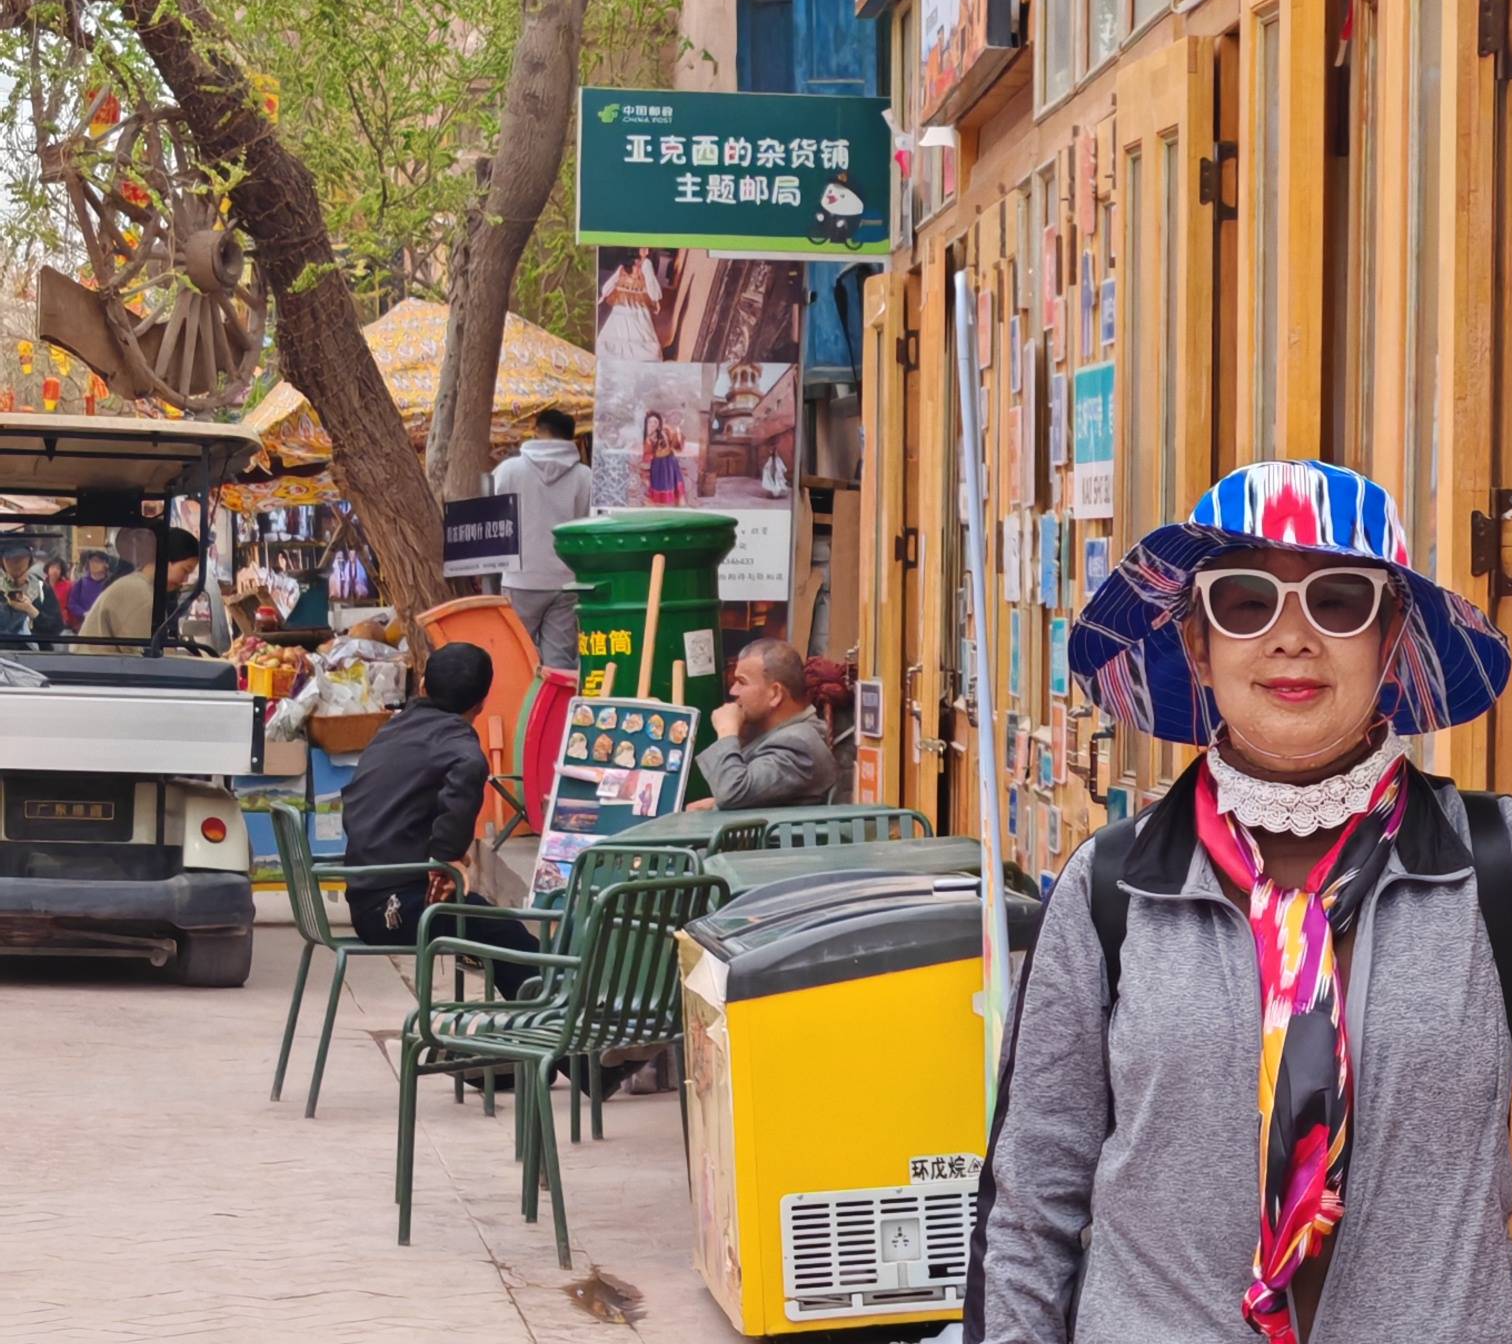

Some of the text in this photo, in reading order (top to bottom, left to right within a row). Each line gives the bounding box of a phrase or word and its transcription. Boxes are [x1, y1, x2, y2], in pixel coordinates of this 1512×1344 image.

[622, 104, 674, 117] 中国邮政
[623, 134, 850, 170] 亚克西的杂货铺
[674, 171, 802, 207] 主题邮局
[911, 1155, 967, 1181] 环戊烷
